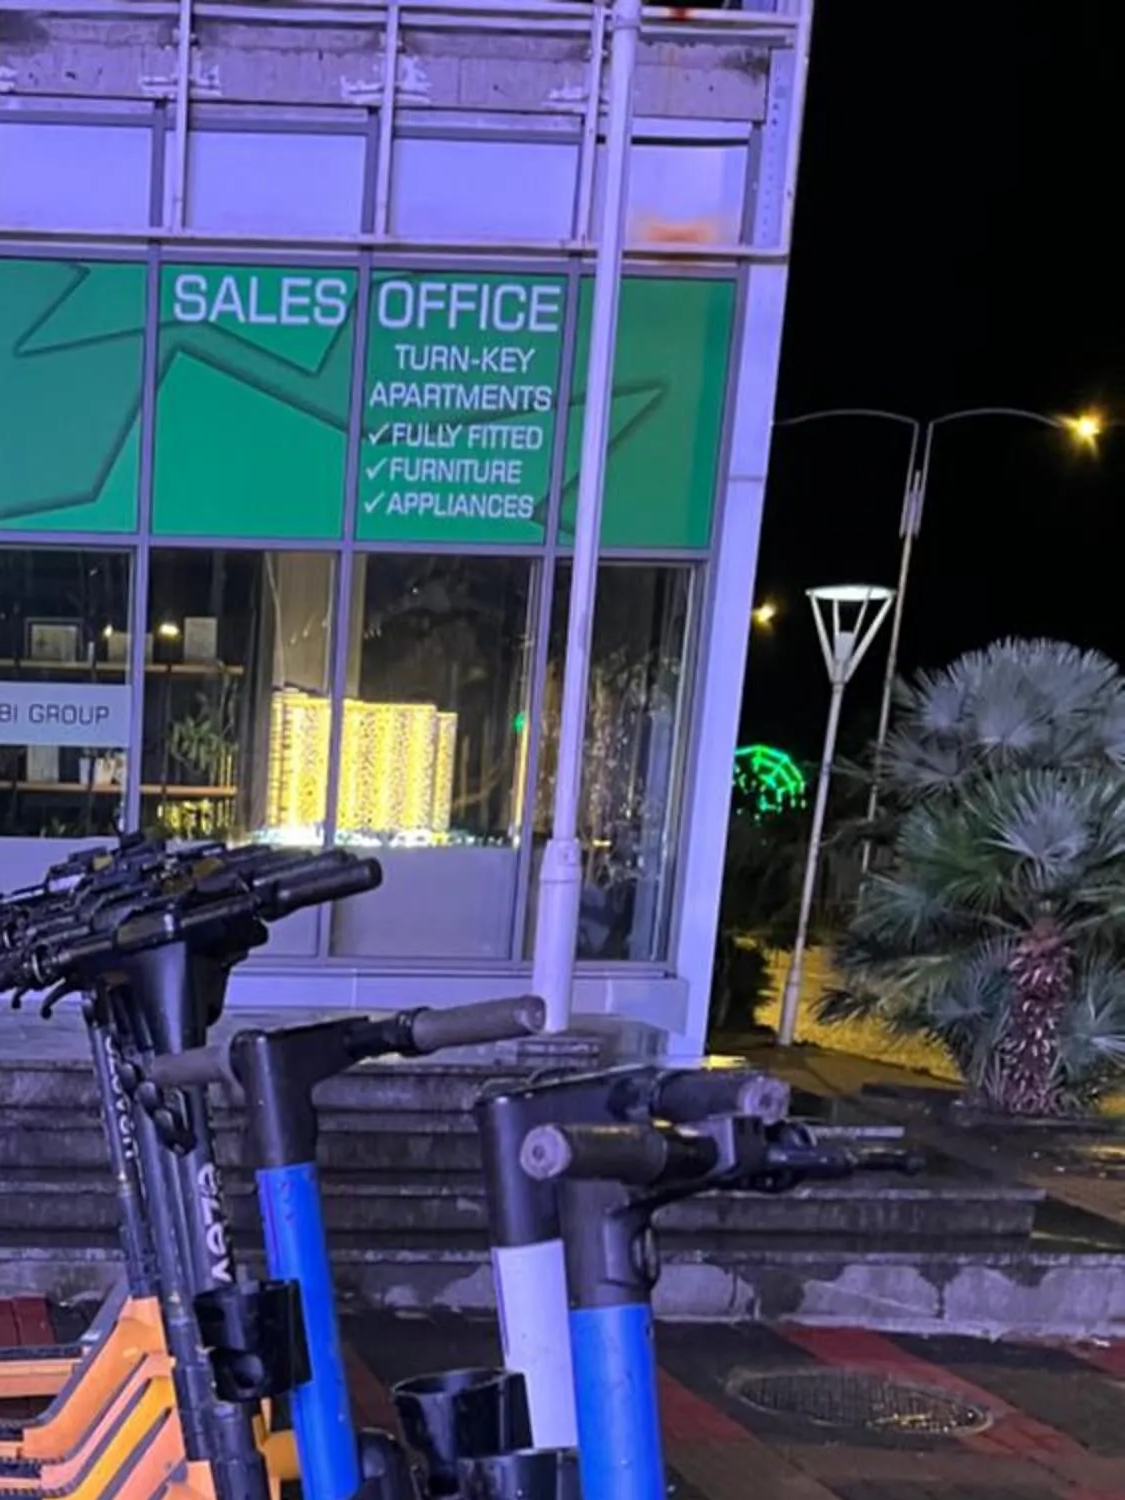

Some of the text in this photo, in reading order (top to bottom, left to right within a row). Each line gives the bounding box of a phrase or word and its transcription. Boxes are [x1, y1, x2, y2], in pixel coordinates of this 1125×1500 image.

[174, 273, 562, 332] SALES OFFICE
[395, 343, 536, 374] TURN-KEY
[369, 382, 553, 412] APARTMENTS
[392, 422, 543, 450] FULLY FITTED
[389, 457, 523, 484] FURNITURE
[386, 490, 535, 519] APPLIANCES
[28, 703, 110, 725] GROUP
